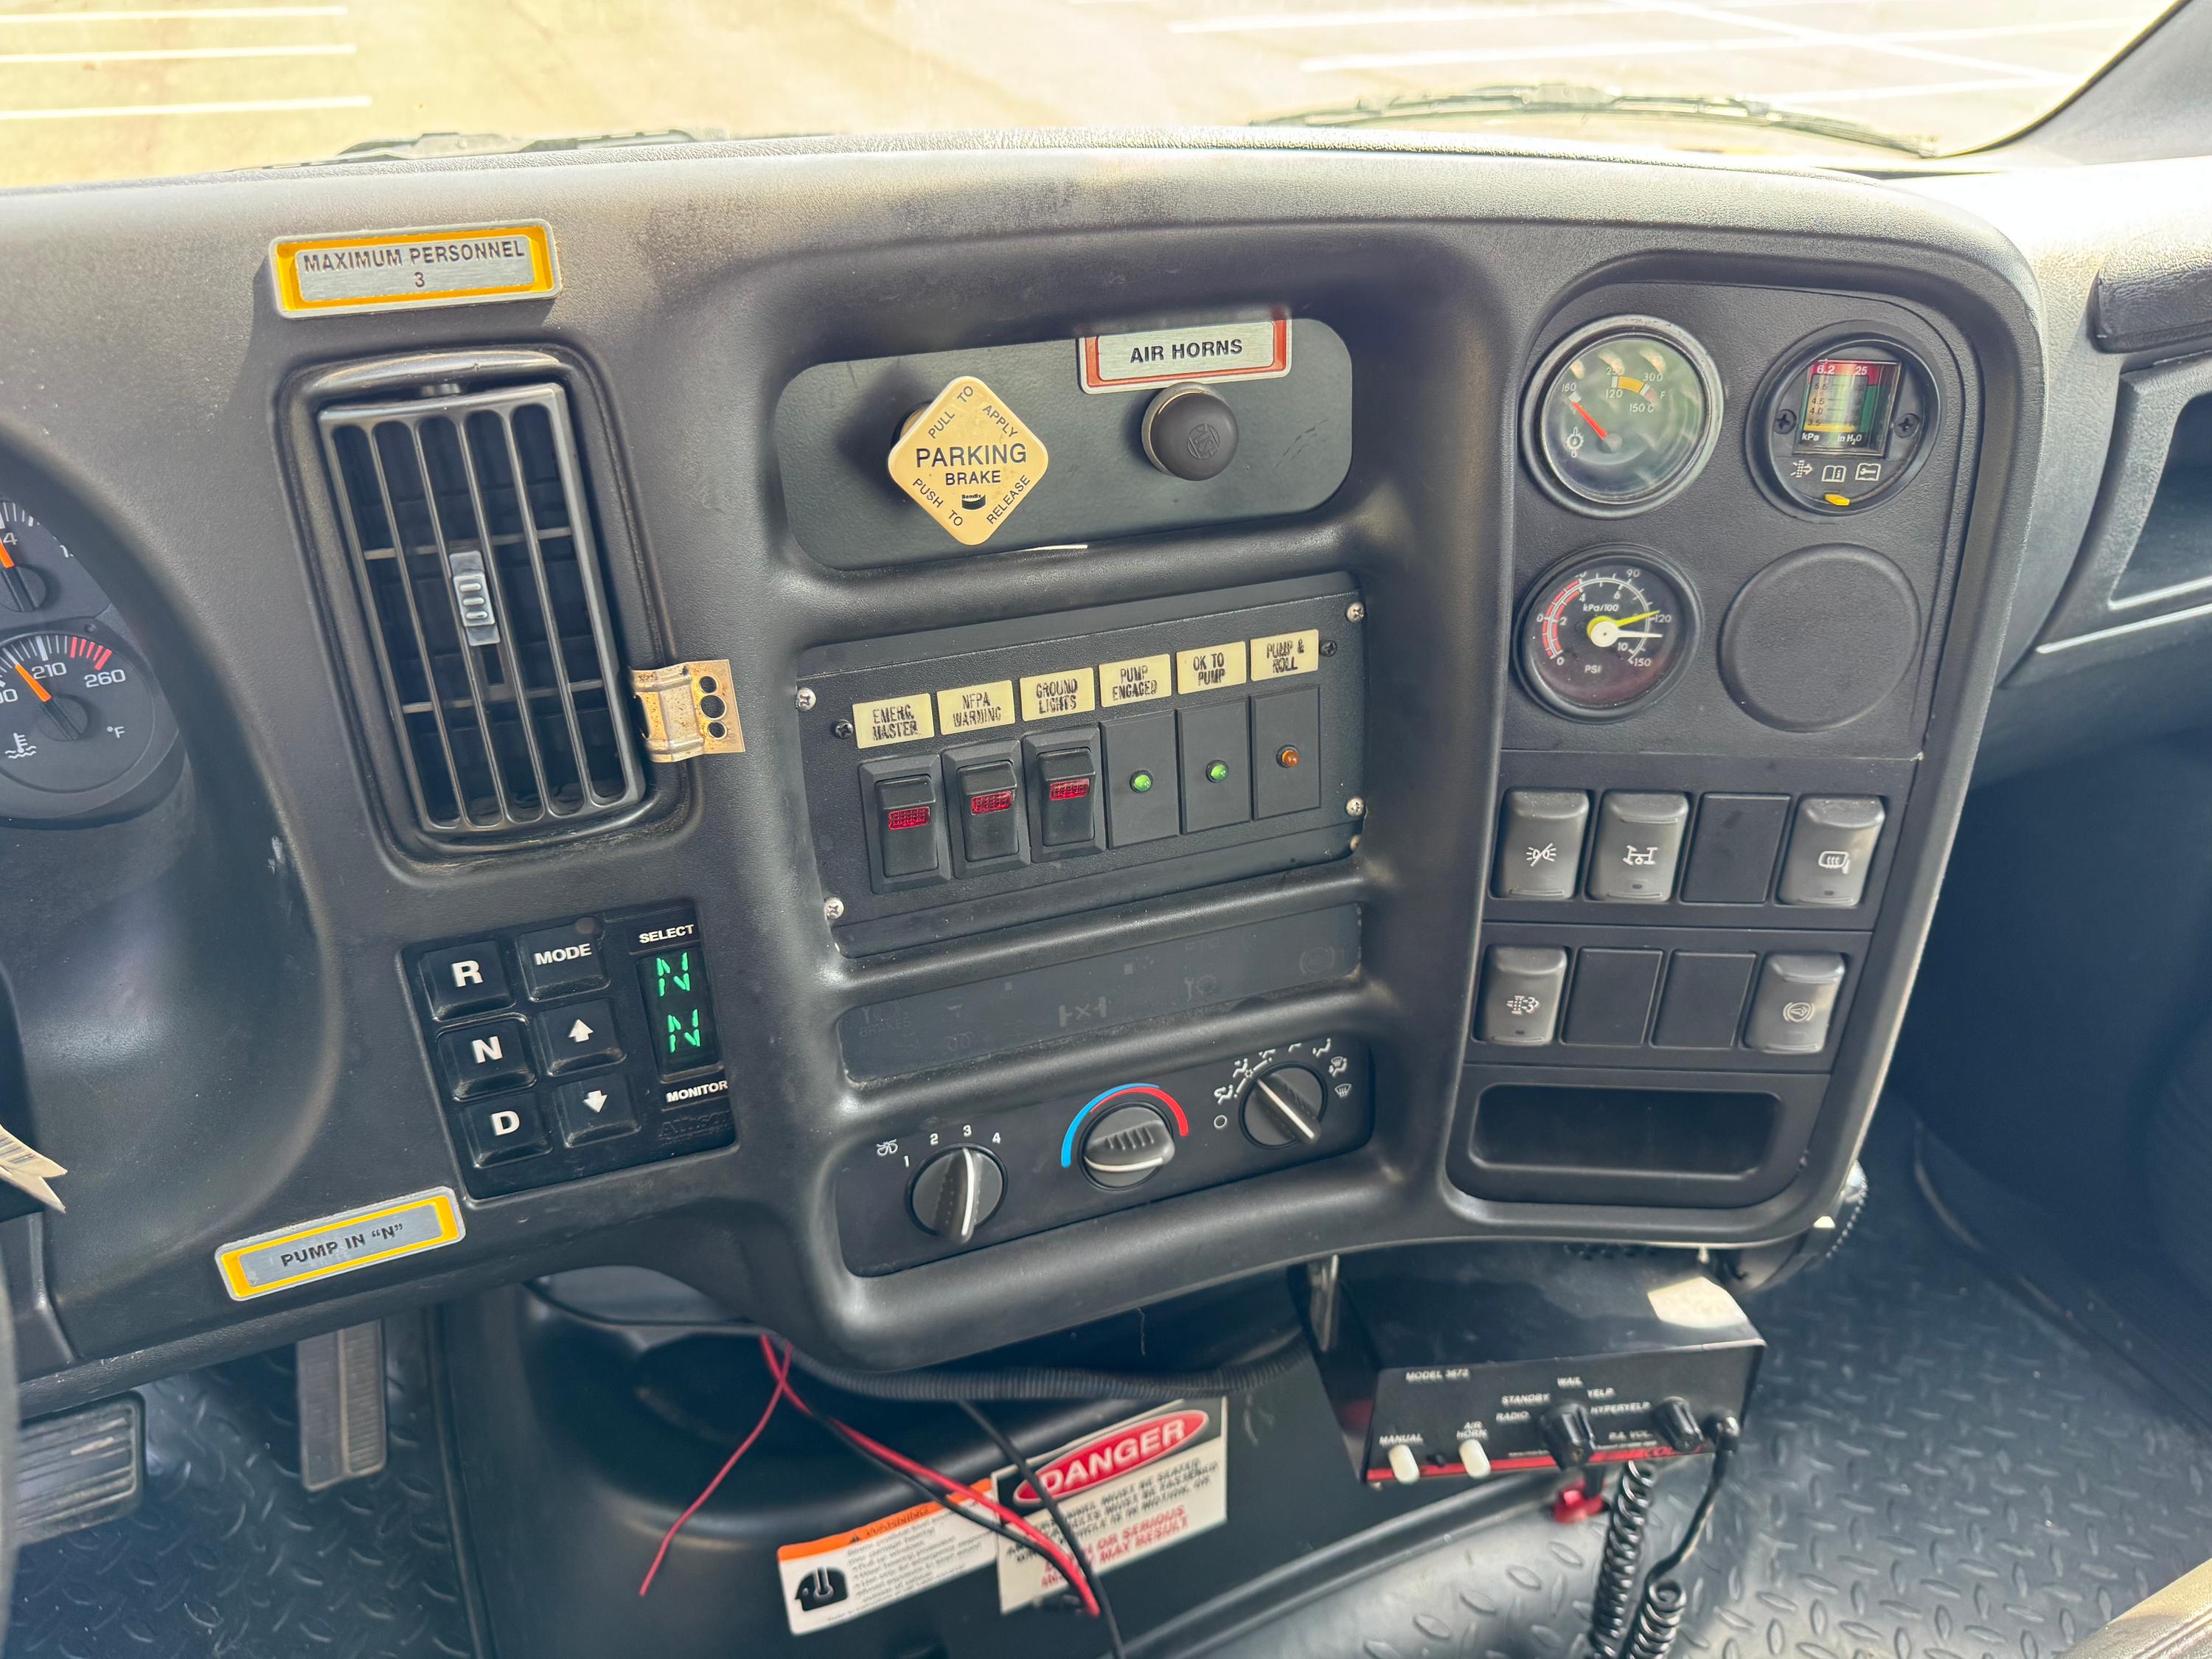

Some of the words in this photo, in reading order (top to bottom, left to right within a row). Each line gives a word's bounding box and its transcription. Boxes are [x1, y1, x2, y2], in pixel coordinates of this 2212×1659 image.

[304, 249, 402, 272] MAXIMUM
[410, 240, 525, 266] PERSONNEL
[415, 272, 425, 288] 3
[1130, 346, 1164, 363] AIR
[1172, 338, 1242, 360] HORNS
[1643, 372, 1663, 382] 300
[1817, 364, 1835, 375] 6.2
[1854, 366, 1868, 375] 25
[1562, 383, 1576, 392] 160
[1605, 389, 1623, 398] 120
[928, 411, 956, 439] PULL
[956, 386, 973, 403] TO
[982, 405, 1018, 438] APPLY
[1801, 433, 1820, 442] kPa
[916, 442, 1027, 468] PARKING
[945, 470, 1001, 486] BRAKE
[912, 478, 944, 508] PUSH
[948, 509, 964, 526] TO
[986, 474, 1031, 524] RELEASE
[1627, 569, 1640, 577] 90
[1579, 593, 1586, 602] 4
[1613, 591, 1621, 599] 6
[1583, 603, 1620, 612] kPa/100
[1559, 616, 1567, 625] 2
[1655, 614, 1672, 623] 120
[1267, 640, 1293, 658] PUMP
[1298, 639, 1304, 654] &
[1618, 642, 1628, 651] 10
[1193, 655, 1207, 671] OK
[1211, 652, 1224, 667] TO
[1273, 656, 1298, 673] ROLL
[1557, 658, 1564, 666] 0
[1585, 665, 1601, 673] PSI
[1634, 658, 1651, 667] 150
[31, 663, 67, 680] 210
[83, 669, 126, 688] 260
[1120, 666, 1148, 684] PUMP
[1198, 668, 1225, 686] PUMP
[1036, 678, 1078, 698] GROUND
[1112, 680, 1158, 700] ENGAGED
[962, 692, 990, 709] NFPA
[1039, 696, 1077, 714] LIGHTS
[953, 706, 1002, 727] WARNING
[873, 720, 918, 740] MASTER
[639, 924, 695, 944] SELECT
[452, 960, 484, 987] R
[535, 944, 591, 965] MODE
[656, 952, 690, 997] N
[667, 1009, 700, 1053] N
[472, 1036, 504, 1063] N
[666, 1080, 728, 1102] MONITOR
[491, 1110, 521, 1136] D
[963, 1124, 972, 1137] 3
[930, 1133, 939, 1145] 2
[992, 1132, 1001, 1144] 4
[904, 1155, 909, 1167] 1
[281, 1242, 338, 1267] PUMP
[345, 1234, 366, 1250] IN
[1406, 1370, 1443, 1382] MODEL
[1557, 1376, 1583, 1388] WAIL
[1501, 1393, 1550, 1406] STANDBY
[1587, 1388, 1615, 1399] YELP
[1496, 1411, 1530, 1423] RADIO
[1464, 1421, 1484, 1430] AIR
[1379, 1433, 1423, 1447] MANUAL
[1456, 1429, 1487, 1440] HORN
[1039, 1419, 1186, 1493] DANGER
